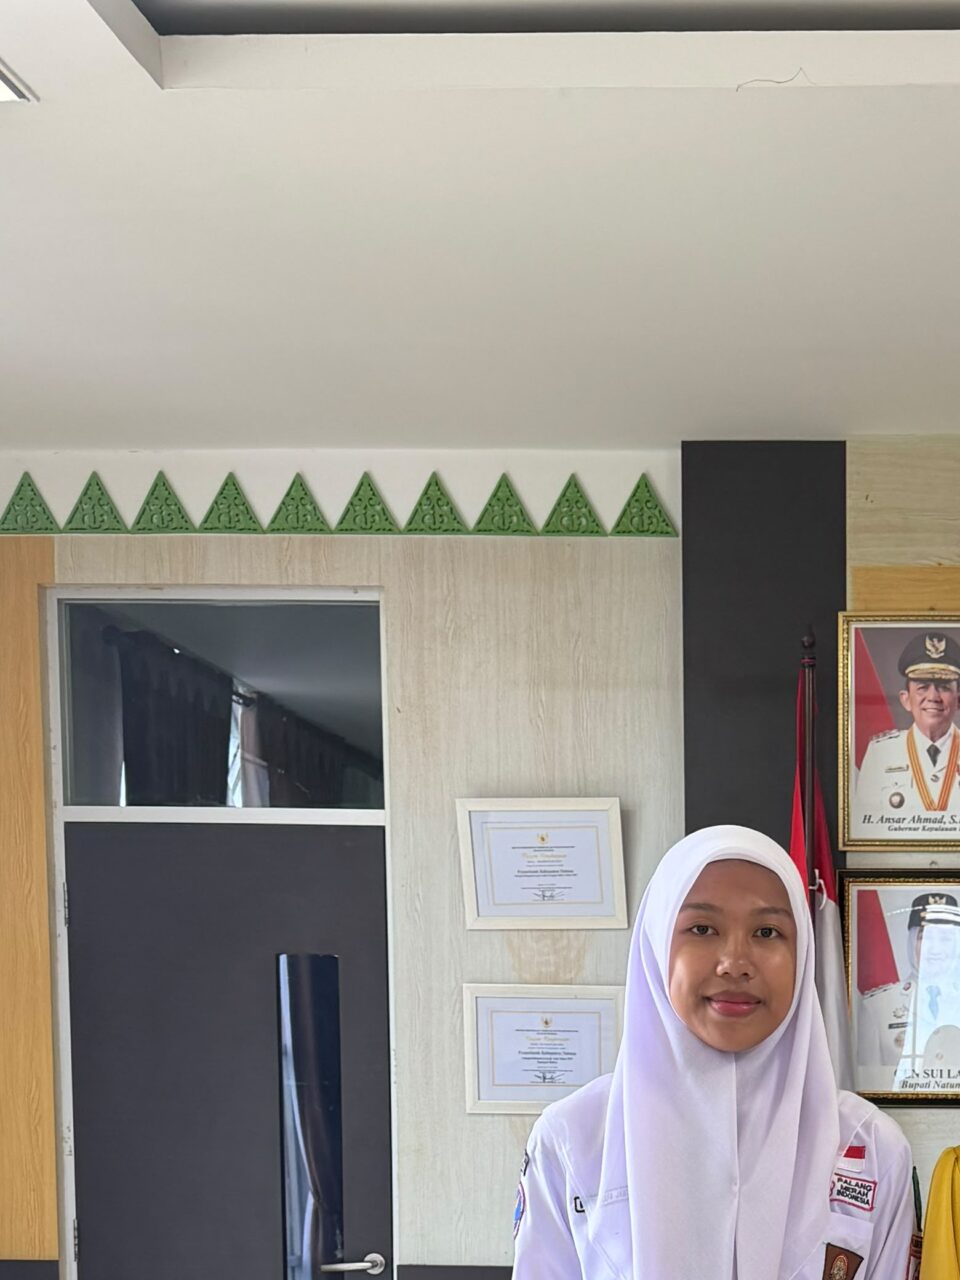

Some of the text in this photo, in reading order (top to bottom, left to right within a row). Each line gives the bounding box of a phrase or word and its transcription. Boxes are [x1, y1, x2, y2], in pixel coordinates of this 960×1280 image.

[862, 815, 873, 824] H.
[877, 815, 906, 824] Ansar
[908, 815, 946, 825] Ahmad,
[923, 1069, 943, 1079] SUI
[901, 1080, 931, 1090] Bupati
[837, 1177, 872, 1192] PALANG
[840, 1184, 869, 1198] MERAH
[836, 1189, 870, 1206] INDONESIA
